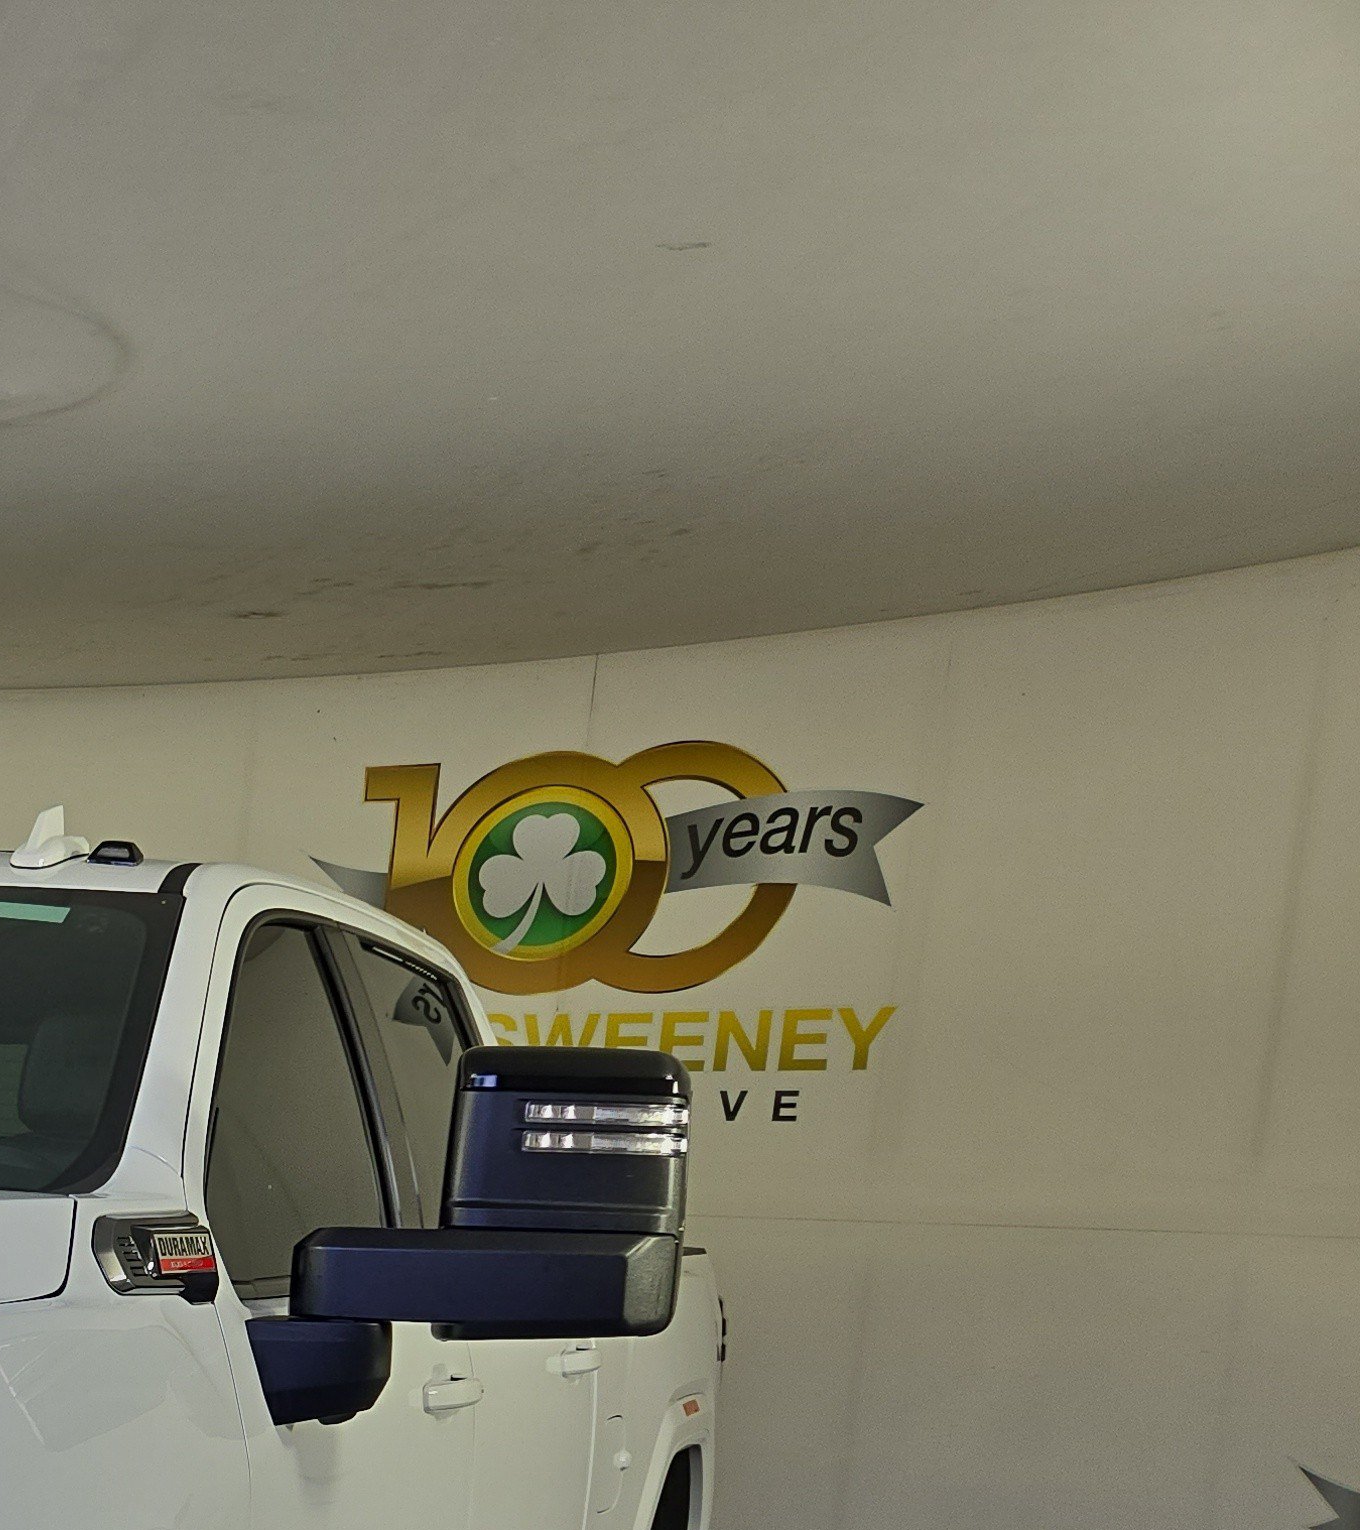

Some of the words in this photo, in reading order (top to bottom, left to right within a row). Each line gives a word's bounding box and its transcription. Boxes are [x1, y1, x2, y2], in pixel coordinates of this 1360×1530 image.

[364, 740, 798, 996] 100
[680, 800, 863, 879] years
[157, 1236, 210, 1257] DURAMAX
